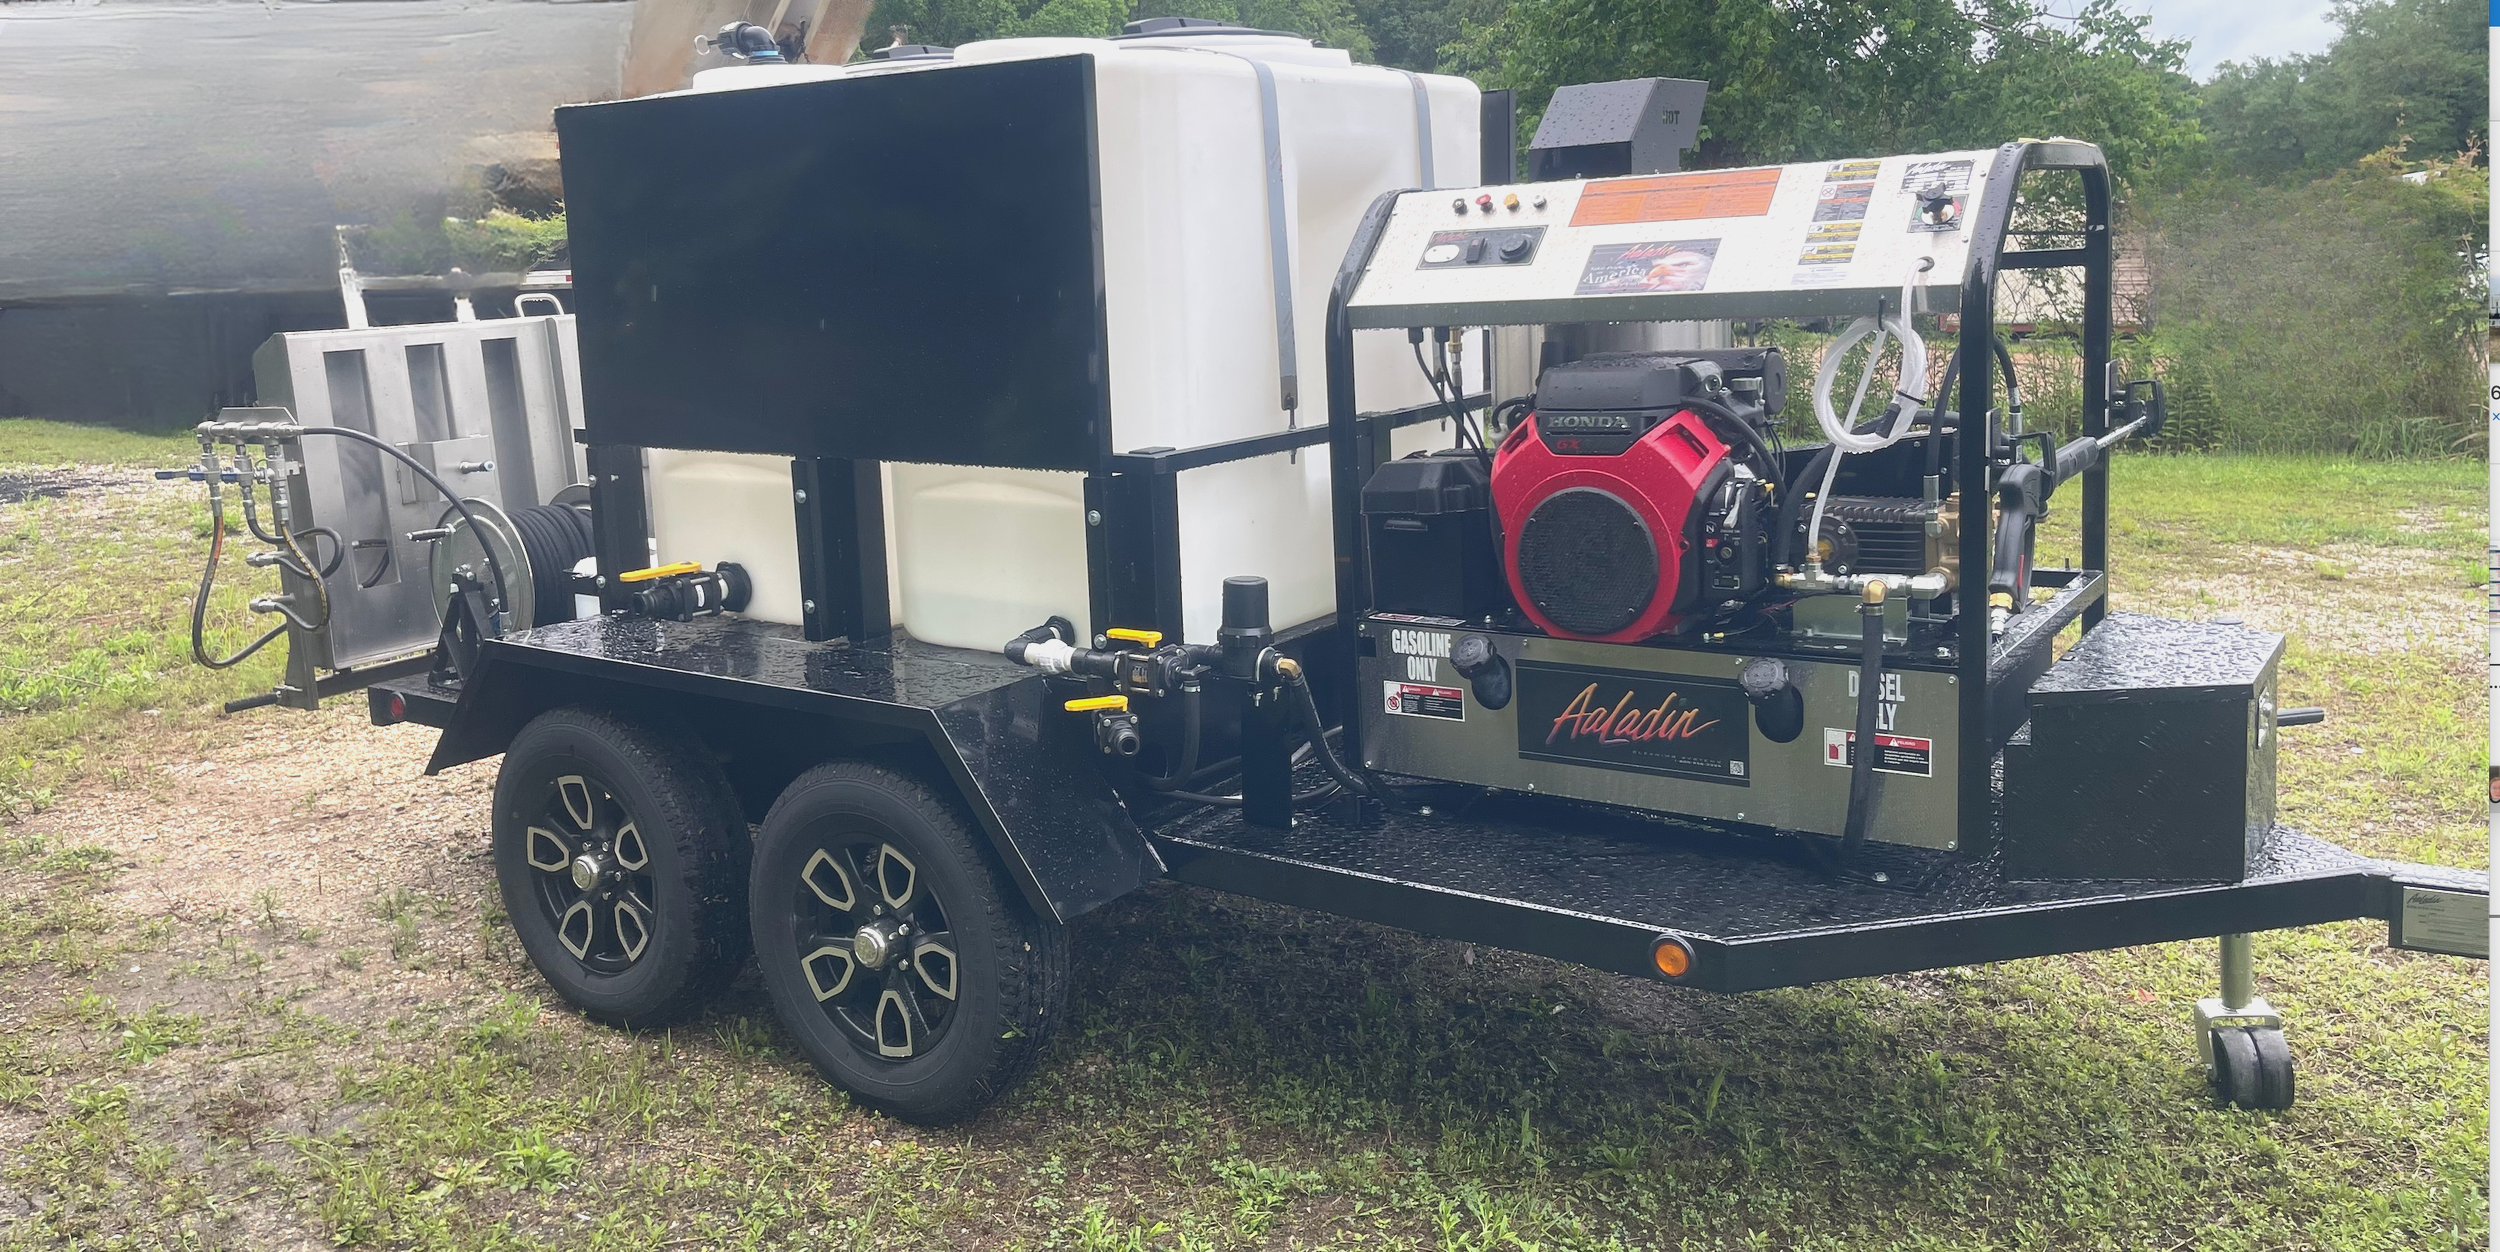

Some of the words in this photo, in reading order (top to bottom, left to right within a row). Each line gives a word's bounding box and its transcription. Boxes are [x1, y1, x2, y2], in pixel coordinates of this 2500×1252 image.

[1662, 109, 1680, 125] HOT
[1583, 265, 1648, 284] America
[1547, 416, 1631, 428] HONDA
[1391, 628, 1451, 658] GASOLINE
[1406, 655, 1438, 682] ONLY
[1848, 670, 1905, 702] DSEL
